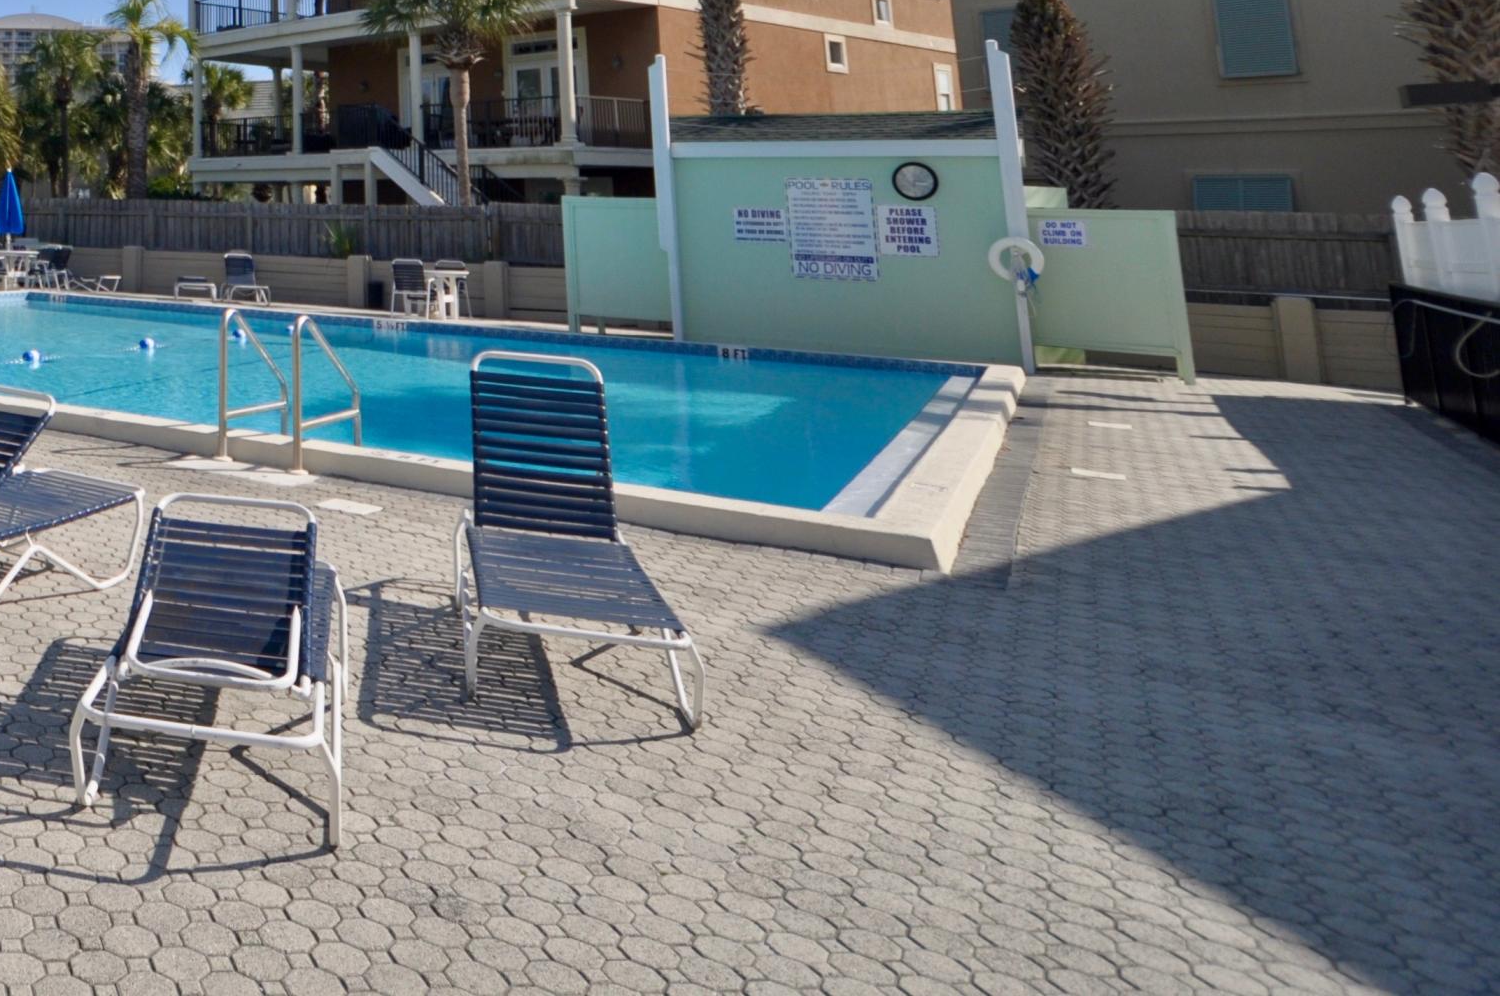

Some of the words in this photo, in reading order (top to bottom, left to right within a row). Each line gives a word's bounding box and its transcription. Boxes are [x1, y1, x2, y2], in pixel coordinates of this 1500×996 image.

[787, 181, 819, 190] POOL
[831, 181, 871, 191] RULES
[737, 209, 749, 218] NO
[751, 209, 781, 219] DIVING
[889, 208, 922, 217] PLEASE
[886, 217, 928, 226] SHOWER
[1045, 221, 1057, 229] DO
[890, 226, 925, 235] BEFORE
[1042, 229, 1067, 237] CLIMB
[885, 235, 932, 245] ENTERING
[1043, 237, 1083, 245] BUILDING
[897, 244, 921, 253] POOL
[798, 262, 820, 273] NO
[823, 263, 872, 276] DIVING
[722, 348, 729, 358] 8
[734, 349, 746, 360] FT
